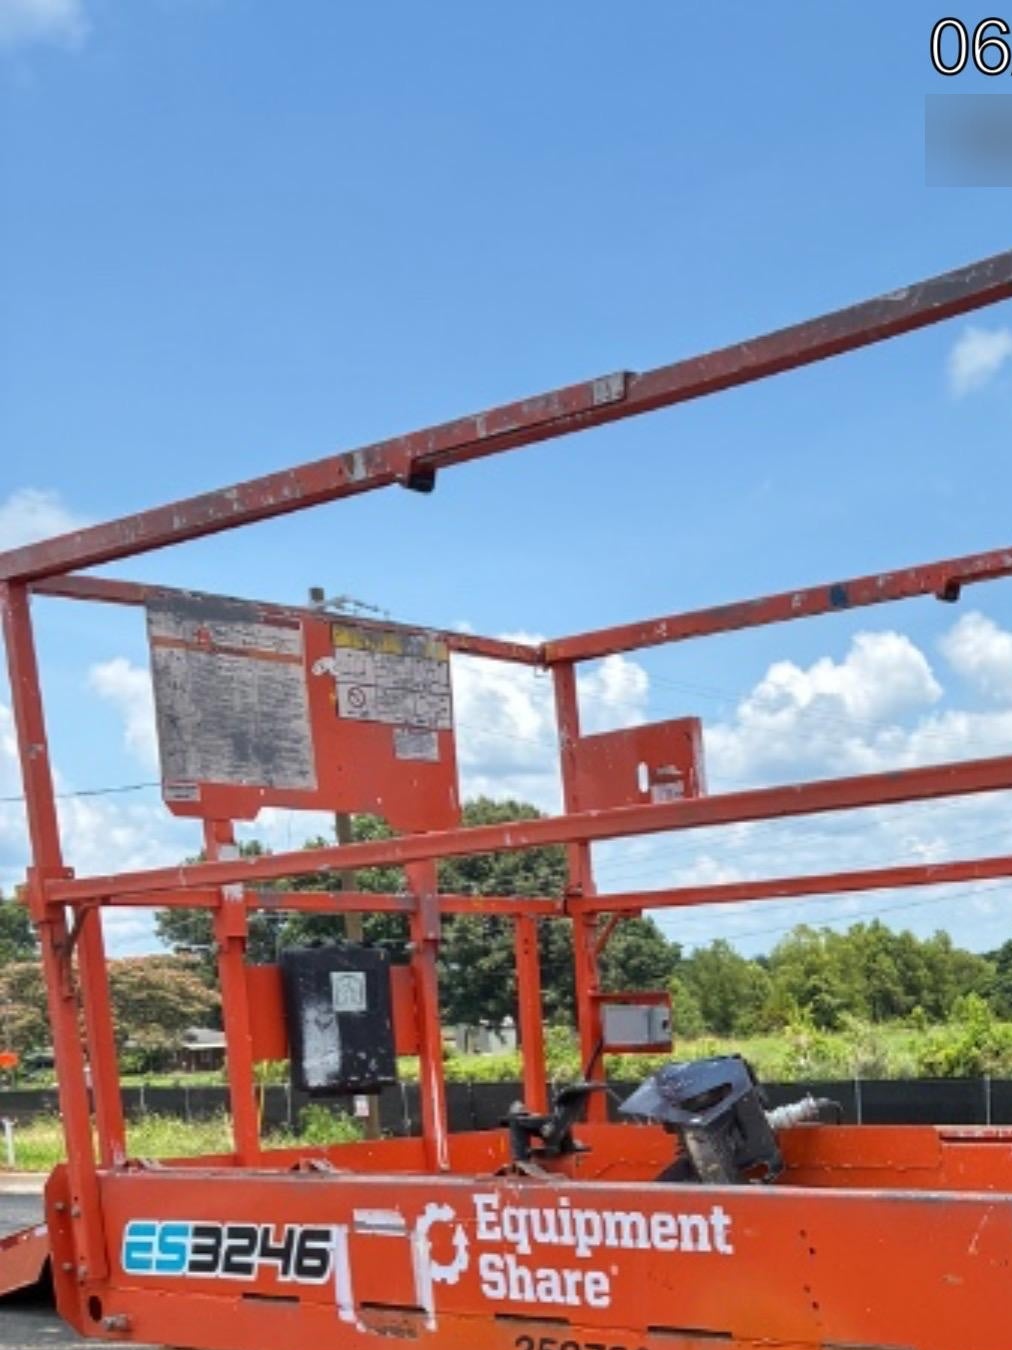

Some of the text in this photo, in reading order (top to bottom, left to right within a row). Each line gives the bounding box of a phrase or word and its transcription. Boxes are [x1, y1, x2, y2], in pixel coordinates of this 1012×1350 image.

[122, 1220, 334, 1284] ES3246
[472, 1193, 734, 1258] Equipment
[478, 1253, 612, 1308] Share
